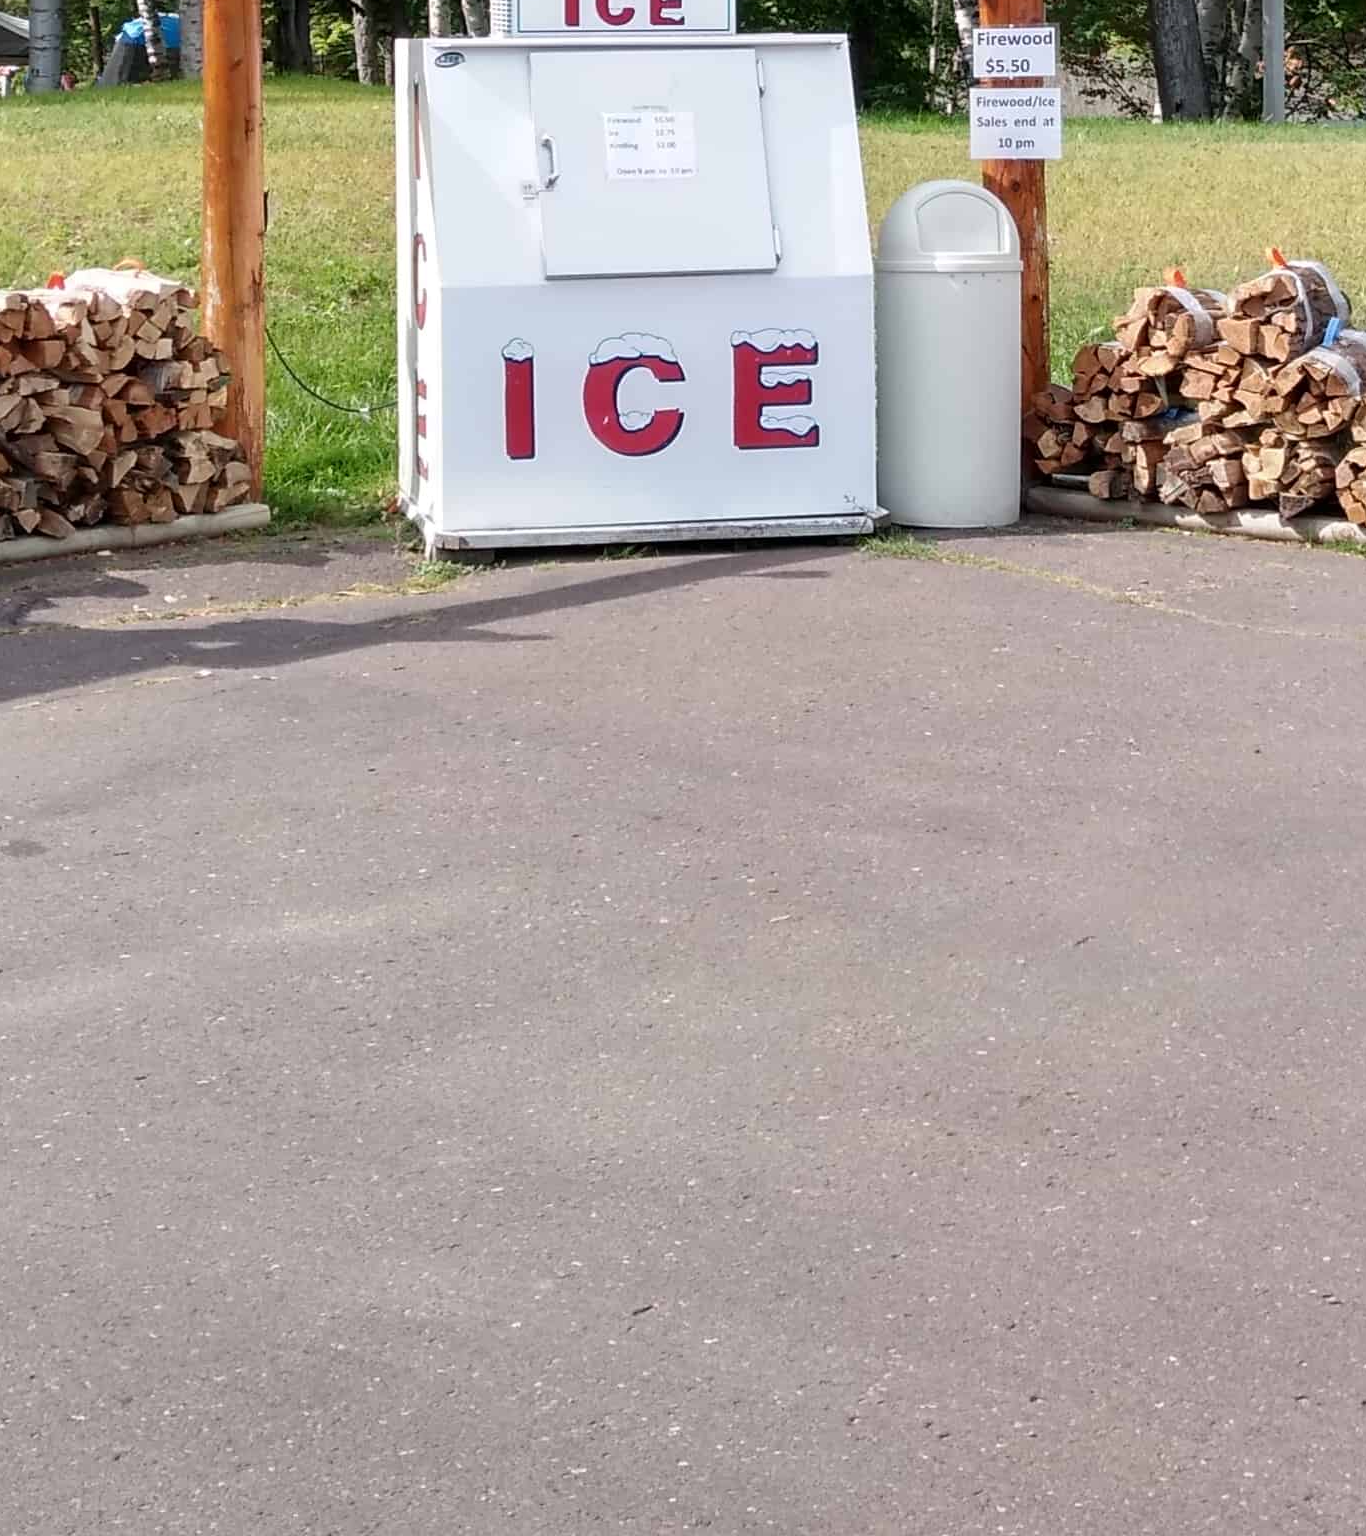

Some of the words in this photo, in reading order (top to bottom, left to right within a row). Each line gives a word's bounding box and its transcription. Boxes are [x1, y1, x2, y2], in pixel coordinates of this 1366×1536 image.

[977, 31, 1053, 46] Firewood
[986, 58, 1030, 73] $5.50
[976, 96, 1055, 108] Firewood/Ice
[977, 117, 1008, 128] Sales
[1014, 116, 1036, 127] end
[1043, 117, 1054, 127] at
[998, 138, 1012, 149] 10
[1015, 138, 1035, 150] pm
[501, 328, 821, 460] ICE
